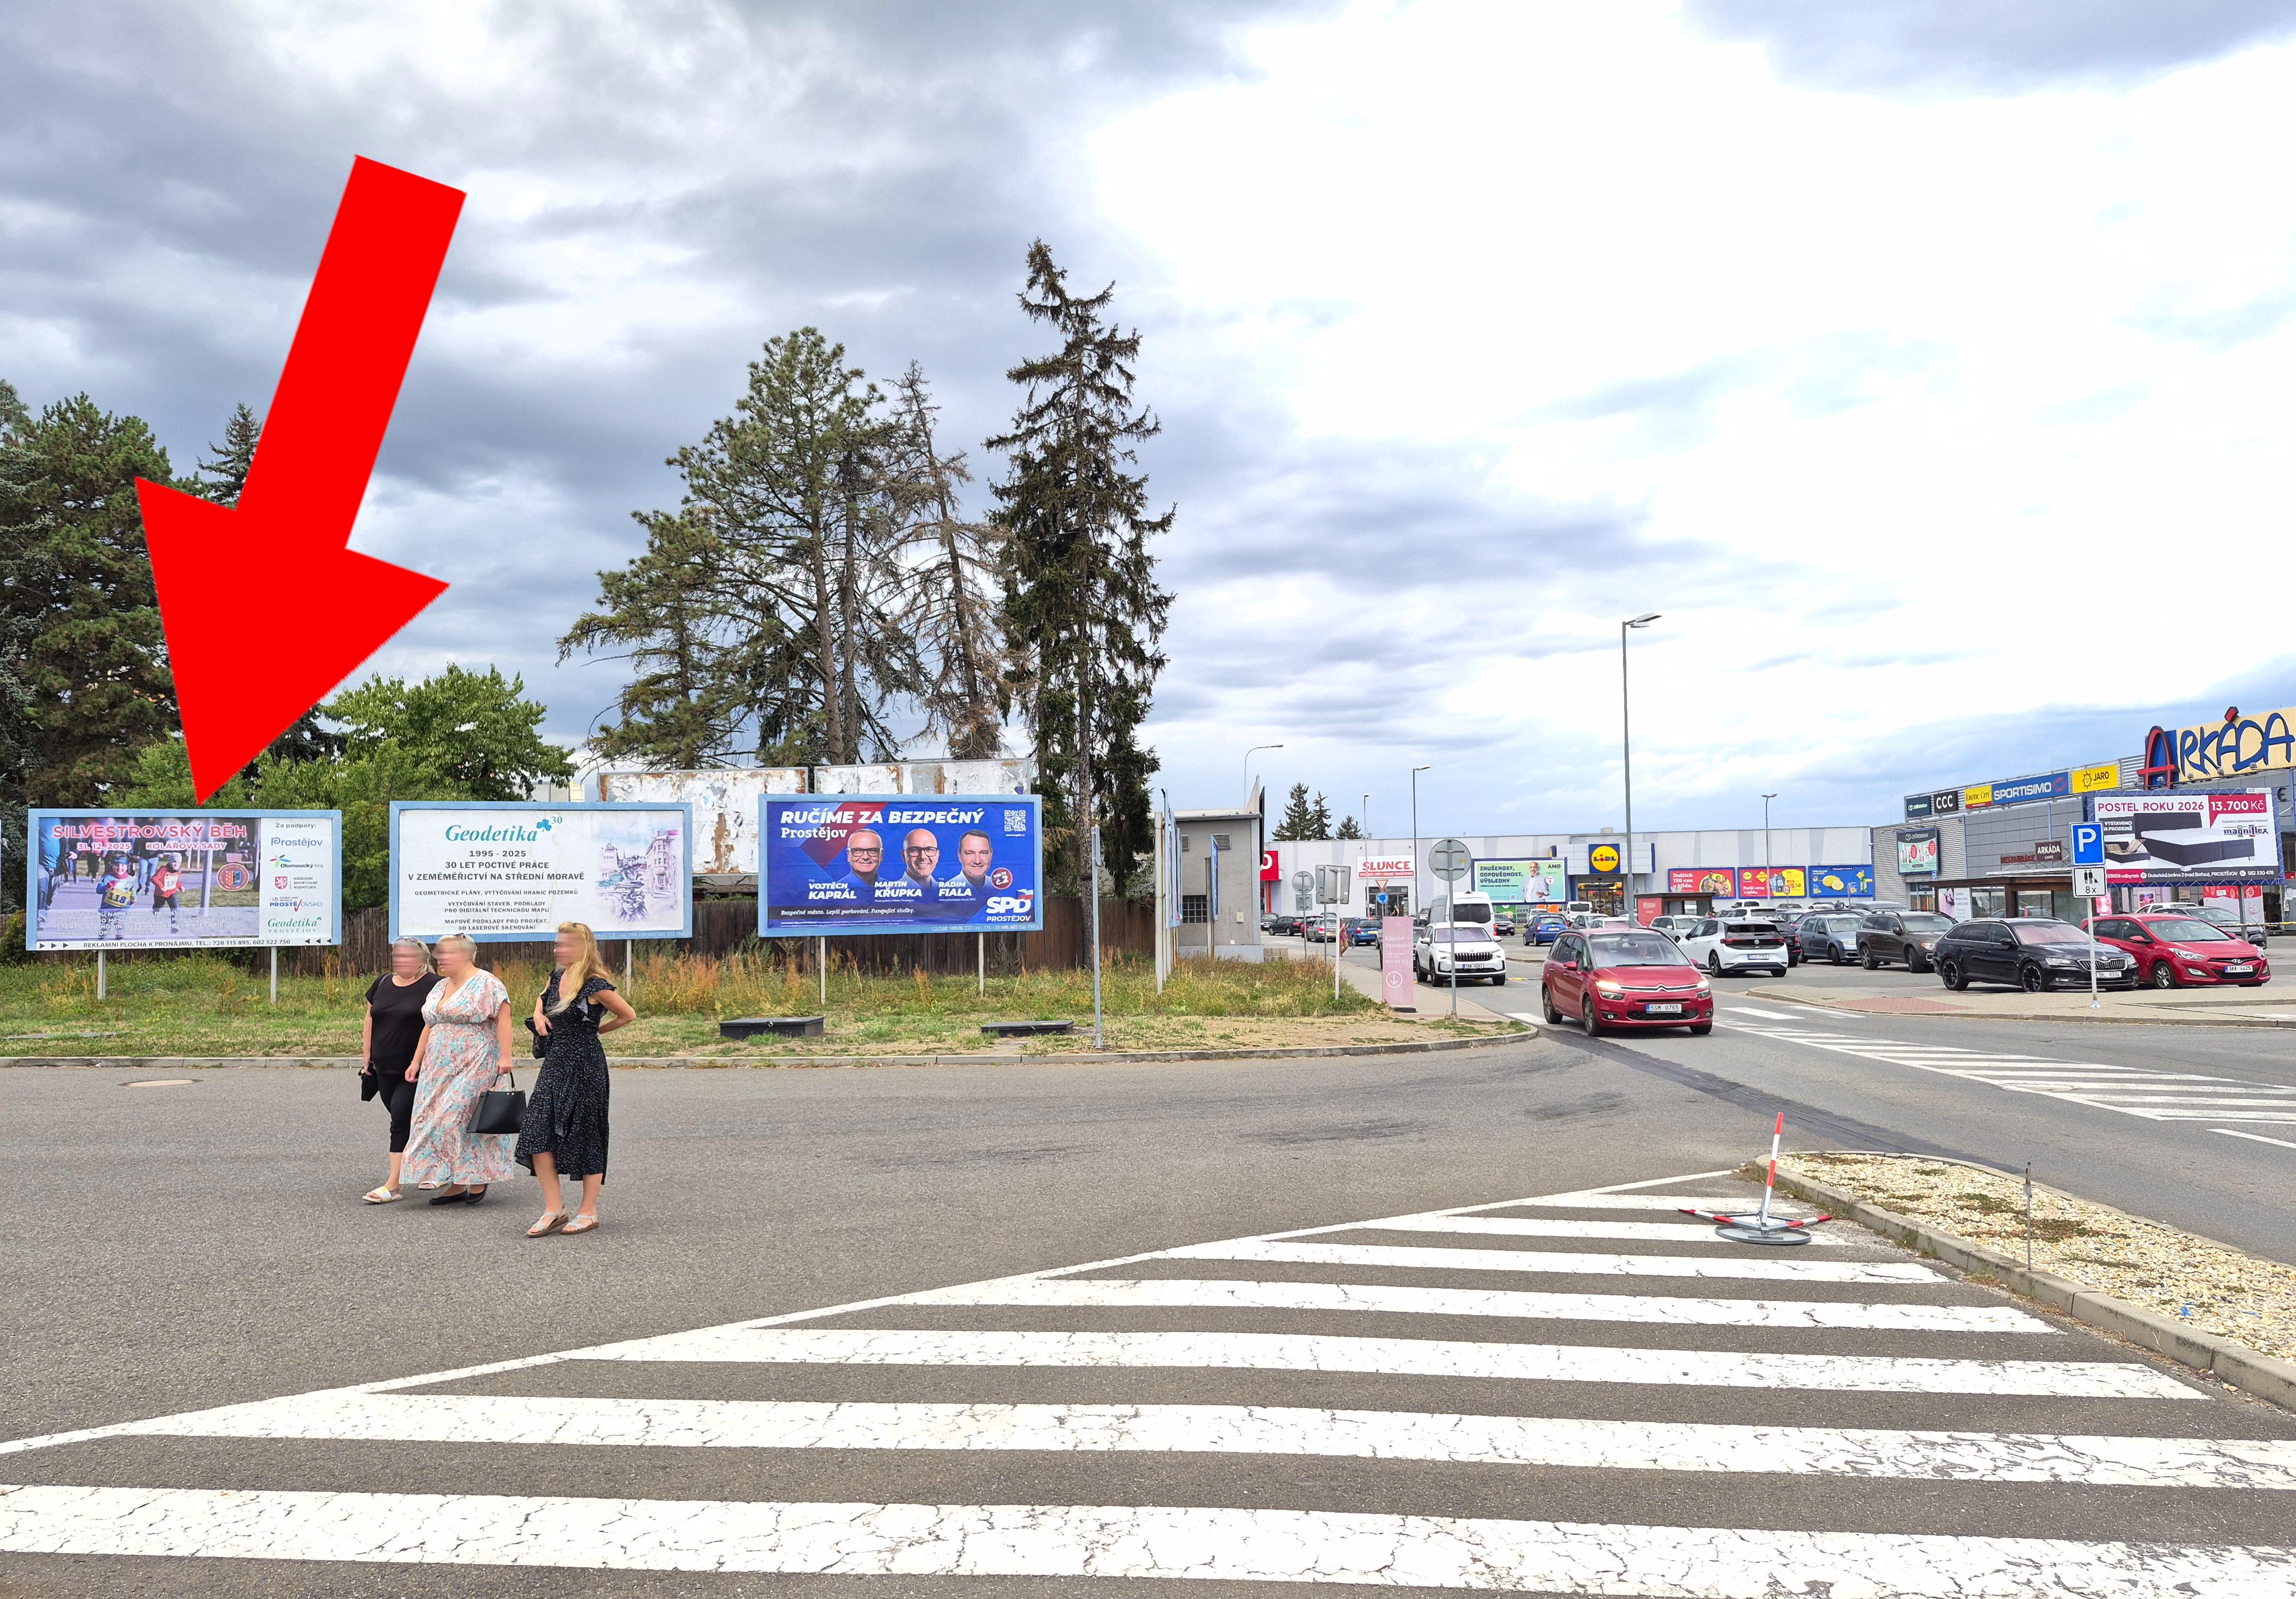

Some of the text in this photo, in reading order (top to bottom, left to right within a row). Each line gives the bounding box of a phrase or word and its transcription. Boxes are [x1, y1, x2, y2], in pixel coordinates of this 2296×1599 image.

[2136, 706, 2295, 790] ARKÁDA
[2093, 771, 2109, 781] JARO
[1994, 781, 2052, 800] SPORTISIMO
[1936, 795, 1953, 809] CCC
[2098, 802, 2204, 812] POSTEL ROKU 2026
[2210, 800, 2264, 811] 13.700 Kč
[781, 808, 985, 823] RUČÍME ZA BEZPEČNÝ
[53, 823, 247, 838] SILVESTROVSKÝ BĚH
[445, 816, 563, 841] Geodetika 30
[781, 827, 847, 841] Prostějov
[2223, 826, 2269, 836] magniflex
[147, 841, 199, 849] KOLÁŘOVY
[271, 837, 323, 848] Prostějov
[2078, 828, 2097, 852] P
[2037, 843, 2061, 854] ARKÁDA
[479, 860, 517, 869] POCTIVÉ
[519, 860, 549, 869] PRÁCE
[1362, 861, 1411, 870] SLUNCE
[417, 872, 487, 880] ZEMĚMĚŘICTVÍ
[505, 872, 544, 880] STŘEDNÍ
[547, 872, 585, 880] MORAVĚ
[995, 876, 1009, 885] č.2
[808, 889, 857, 900] KAPRÁL
[874, 887, 922, 897] KŘUPKA
[938, 888, 972, 897] FIALA
[108, 892, 126, 904] 118
[986, 896, 1031, 914] SPD
[267, 919, 317, 927] Geodetika
